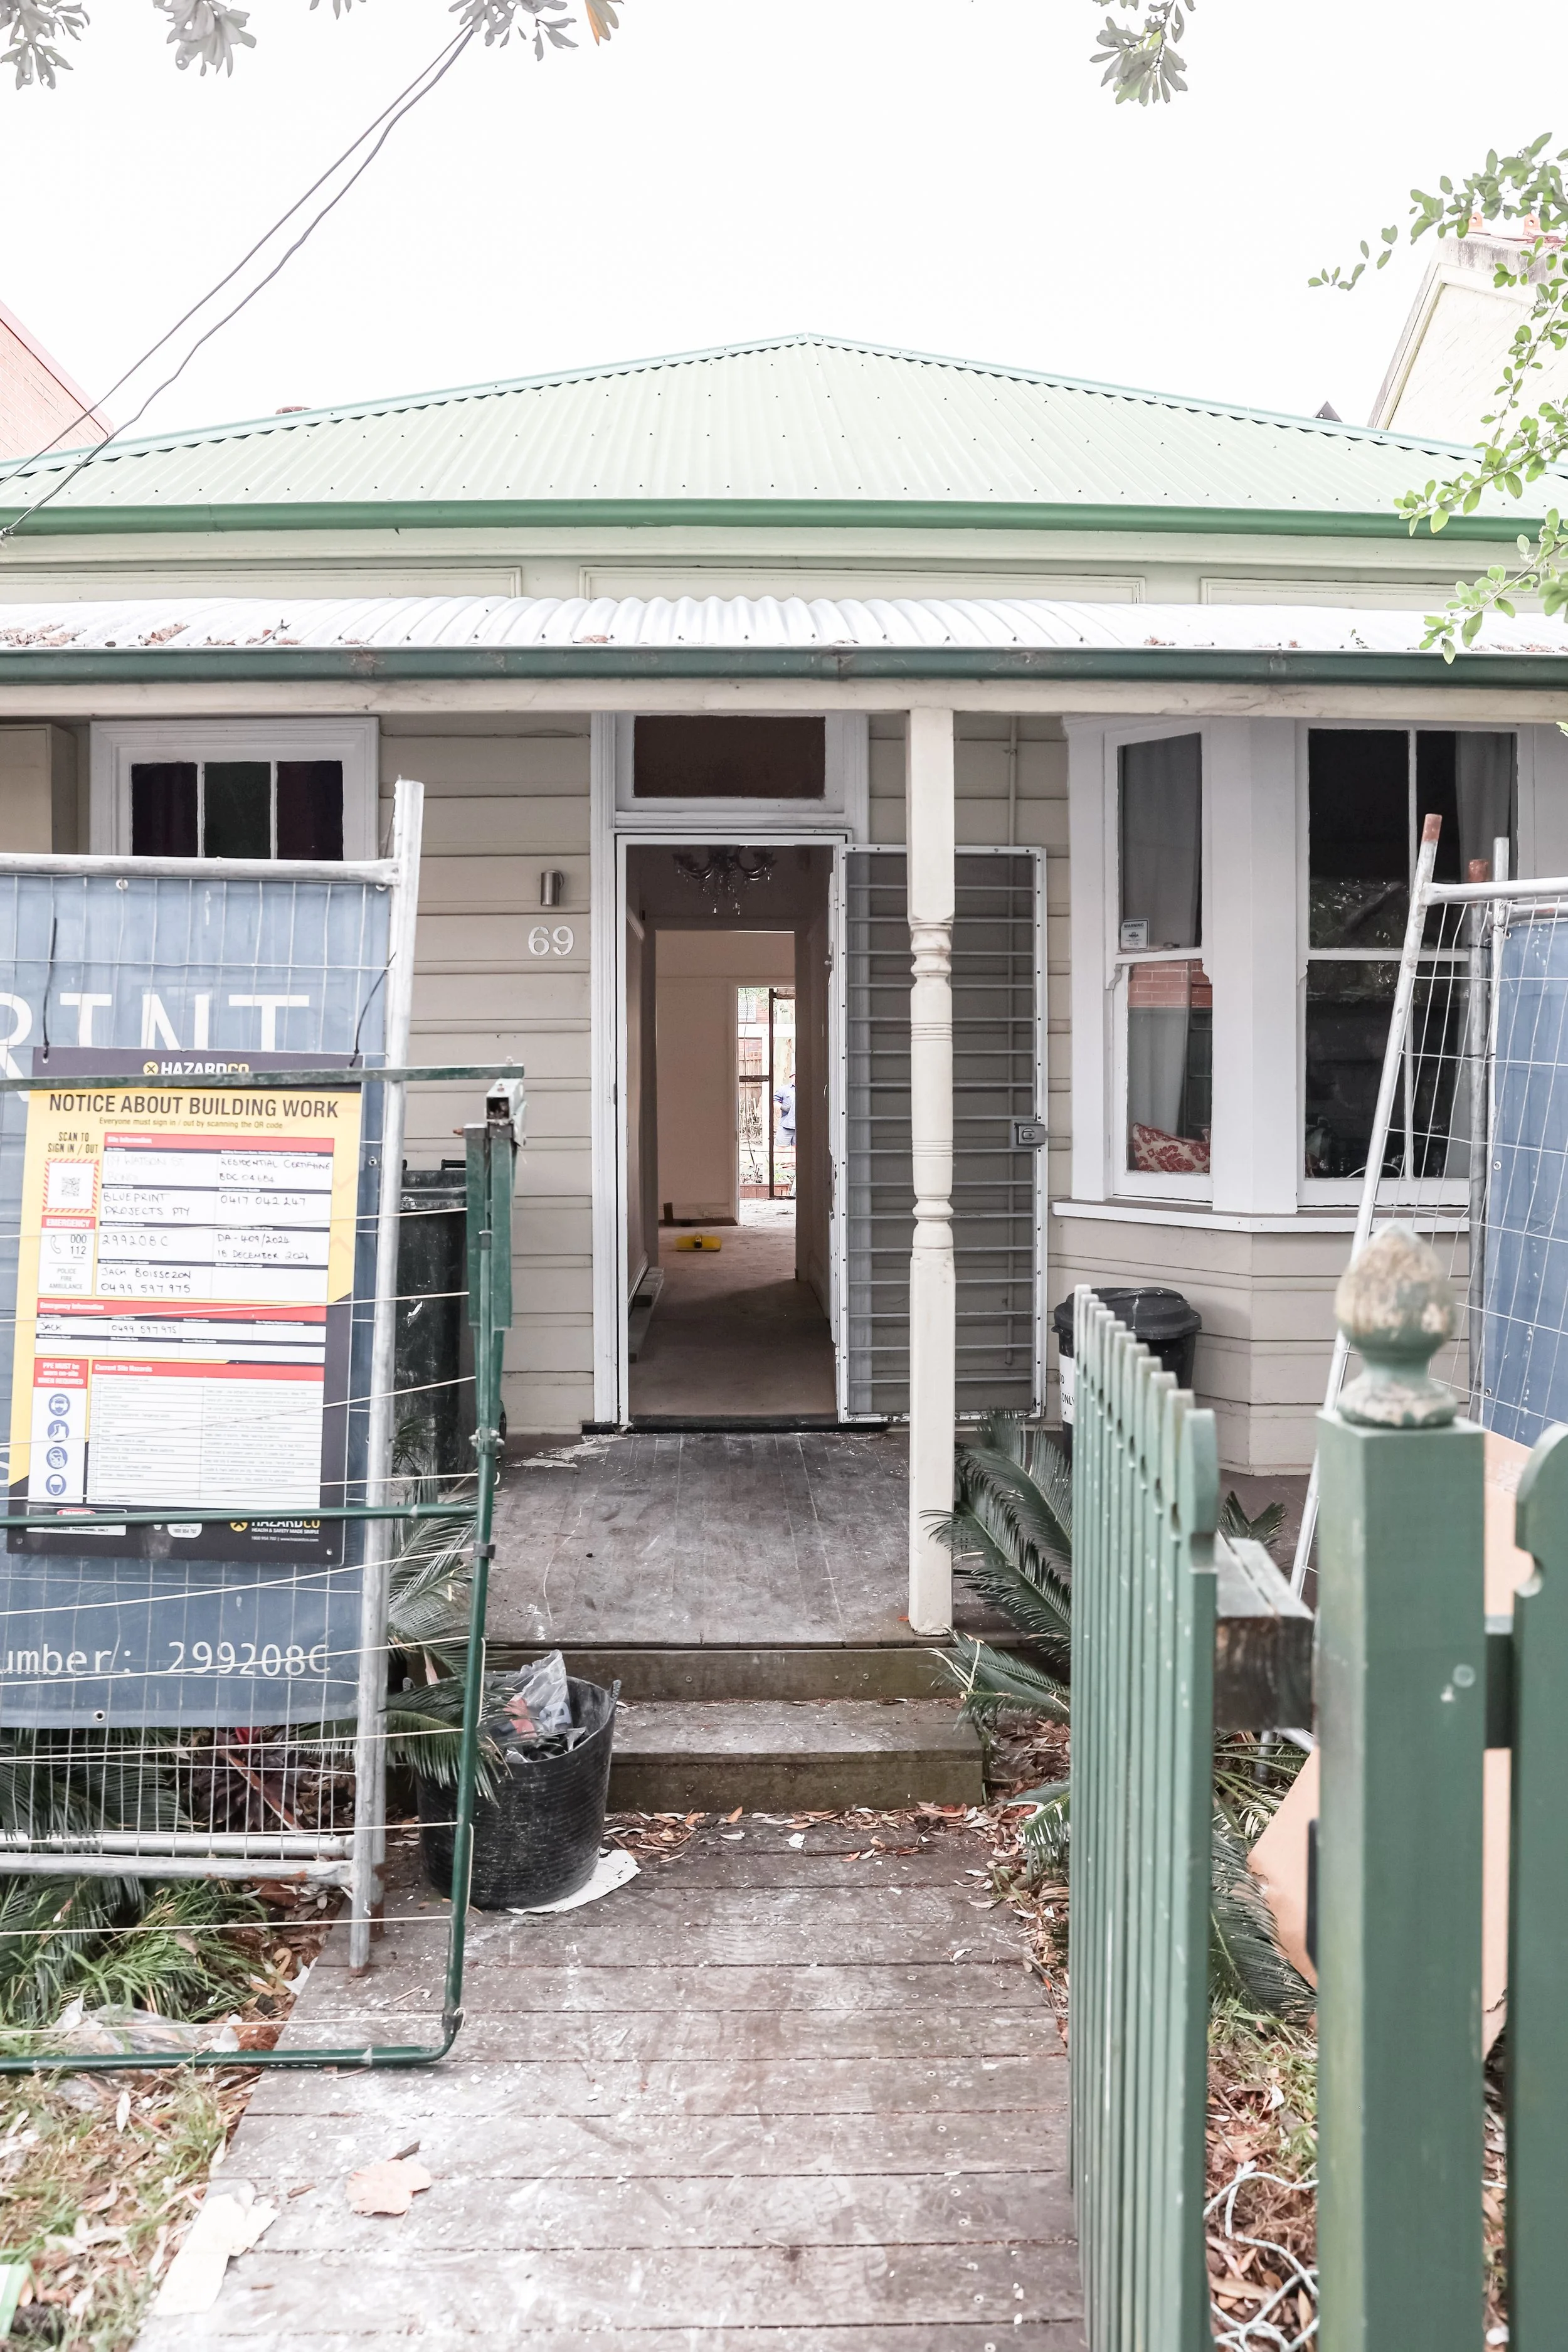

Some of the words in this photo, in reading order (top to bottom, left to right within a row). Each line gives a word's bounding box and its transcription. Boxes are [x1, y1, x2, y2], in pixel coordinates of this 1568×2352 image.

[528, 926, 574, 956] 69
[50, 1094, 115, 1112] NOTICE
[120, 1096, 183, 1114] ABOUT
[189, 1097, 277, 1116] BUILDING
[282, 1099, 339, 1118] WORK
[100, 1117, 131, 1127] Everyone
[153, 1118, 167, 1127] sign
[196, 1120, 204, 1128] by
[207, 1121, 238, 1129] scanning
[59, 1132, 78, 1142] SCAN
[81, 1132, 90, 1142] TO
[48, 1143, 65, 1153] SIGN
[67, 1143, 75, 1153] IN
[77, 1144, 83, 1155] /
[85, 1144, 98, 1153] OUT
[103, 1192, 171, 1203] BLUEPRINT
[220, 1195, 248, 1205] 0417
[255, 1196, 280, 1206] 042
[104, 1205, 164, 1216] PROJECTS
[171, 1206, 190, 1217] PTY
[46, 1219, 90, 1227] EMERGENCY
[71, 1234, 87, 1244] 000
[71, 1246, 87, 1255] 112
[232, 1250, 279, 1260] DECEMBER
[285, 1251, 311, 1261] 2024
[101, 1267, 126, 1276] JACK
[140, 1284, 164, 1294] 597
[169, 1284, 191, 1294] 975
[40, 1322, 63, 1331] JACK
[112, 1324, 134, 1333] 0499
[140, 1325, 159, 1334] 597
[161, 1326, 177, 1335] 975
[167, 1641, 331, 1677] 299208C
